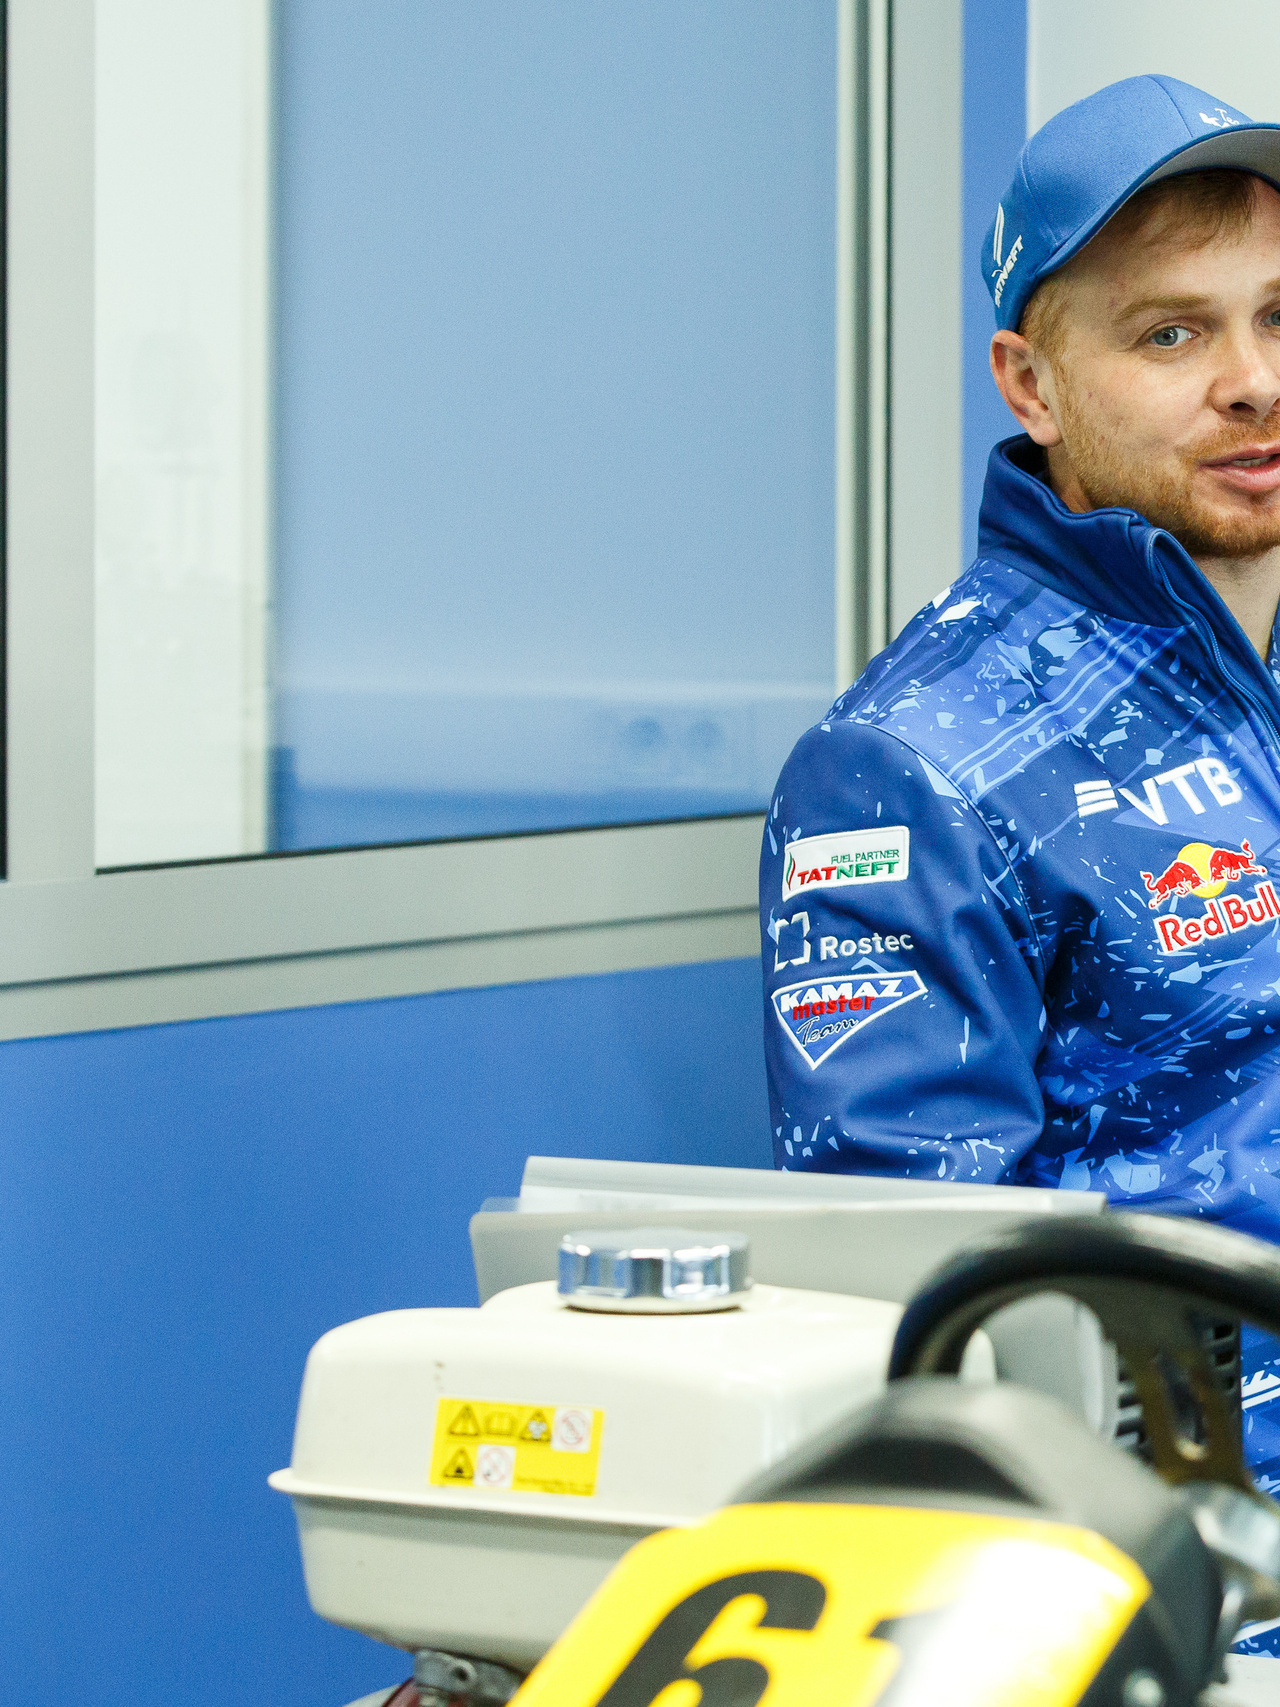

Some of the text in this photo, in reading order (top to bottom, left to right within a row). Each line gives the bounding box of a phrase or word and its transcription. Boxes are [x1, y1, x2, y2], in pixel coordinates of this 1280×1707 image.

[1117, 757, 1243, 826] VTB
[830, 849, 900, 865] FUEL PARTNER
[797, 860, 900, 886] TATNEFT
[1158, 901, 1225, 952] Red
[819, 932, 915, 961] Rostec
[780, 979, 904, 1014] KAMAZ
[792, 994, 876, 1021] master
[796, 1015, 861, 1047] Team
